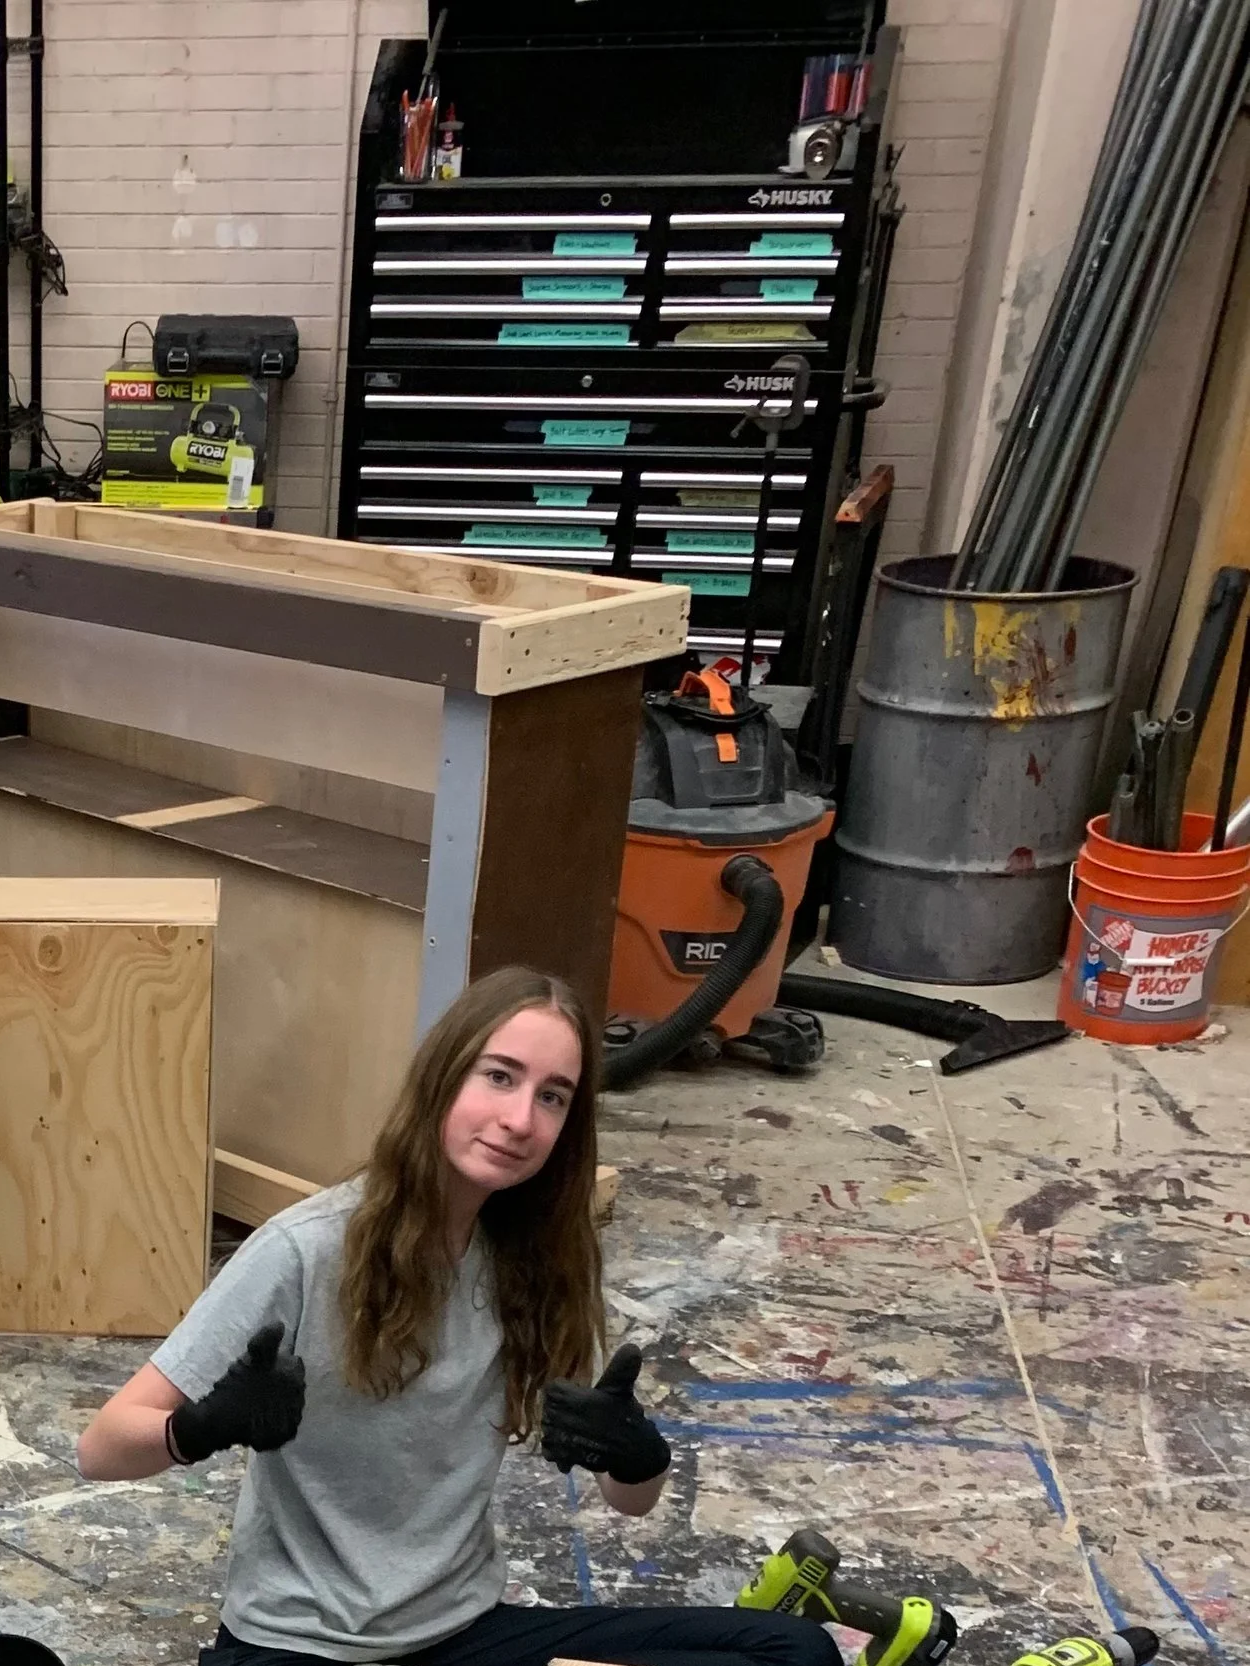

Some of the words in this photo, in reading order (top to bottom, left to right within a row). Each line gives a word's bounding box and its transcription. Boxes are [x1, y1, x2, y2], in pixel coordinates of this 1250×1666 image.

[770, 189, 833, 205] HUSKY
[110, 382, 151, 398] RYOBI
[746, 376, 794, 392] HUSK
[189, 443, 225, 458] RYOBI
[685, 942, 727, 959] RID
